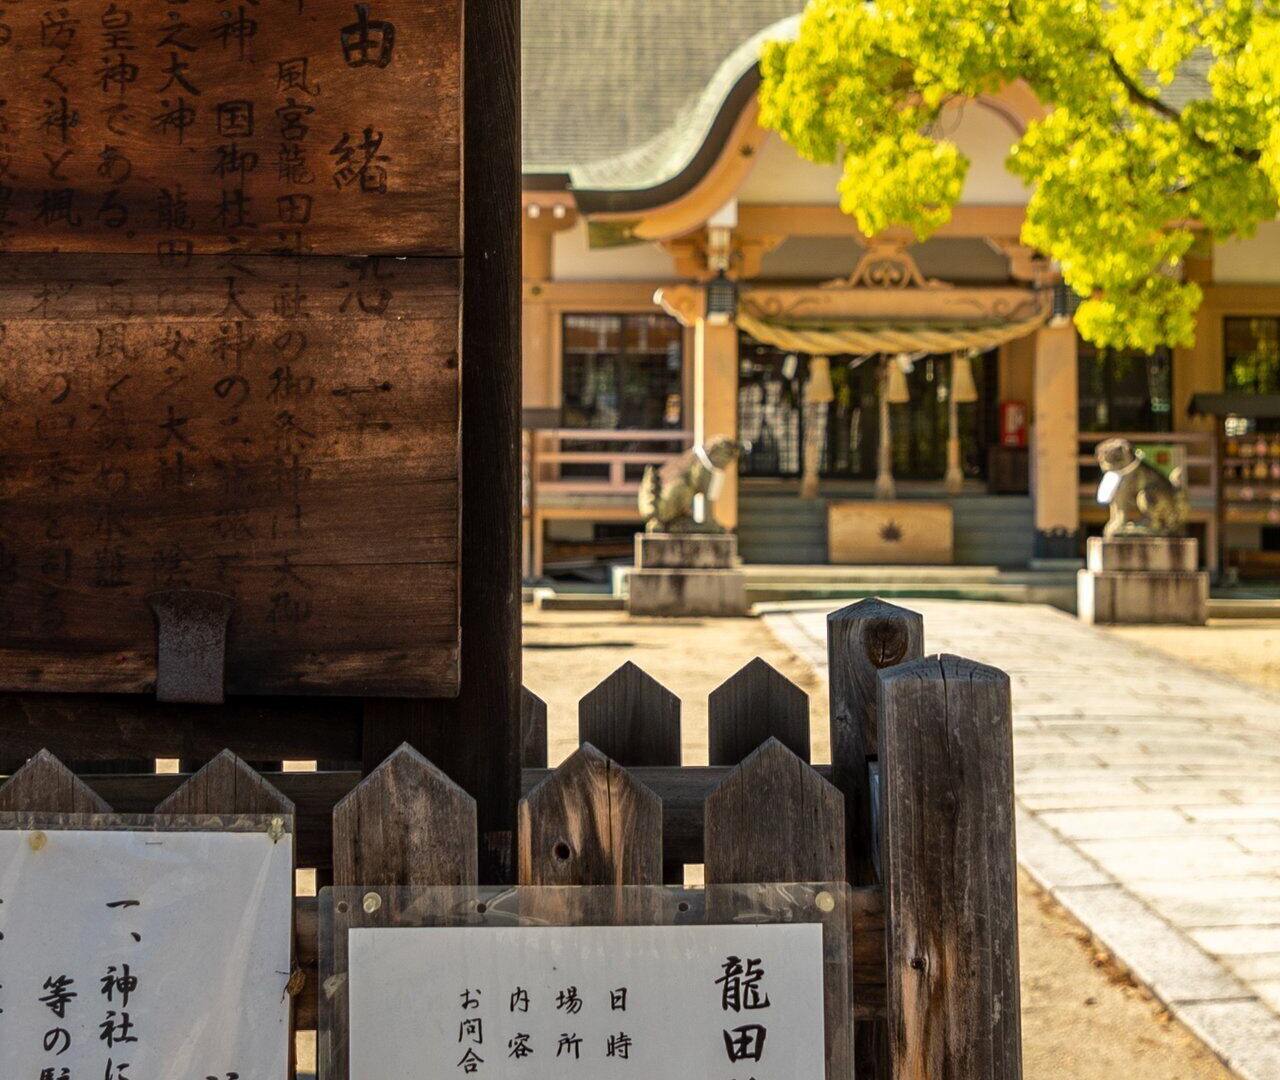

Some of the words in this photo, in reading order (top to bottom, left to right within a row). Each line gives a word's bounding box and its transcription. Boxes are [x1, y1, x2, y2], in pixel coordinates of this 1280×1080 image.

[457, 988, 484, 1074] お問合
[508, 986, 534, 1059] 内容
[555, 987, 583, 1059] 場所
[606, 987, 632, 1059] 日時
[715, 956, 770, 1080] 龍田
